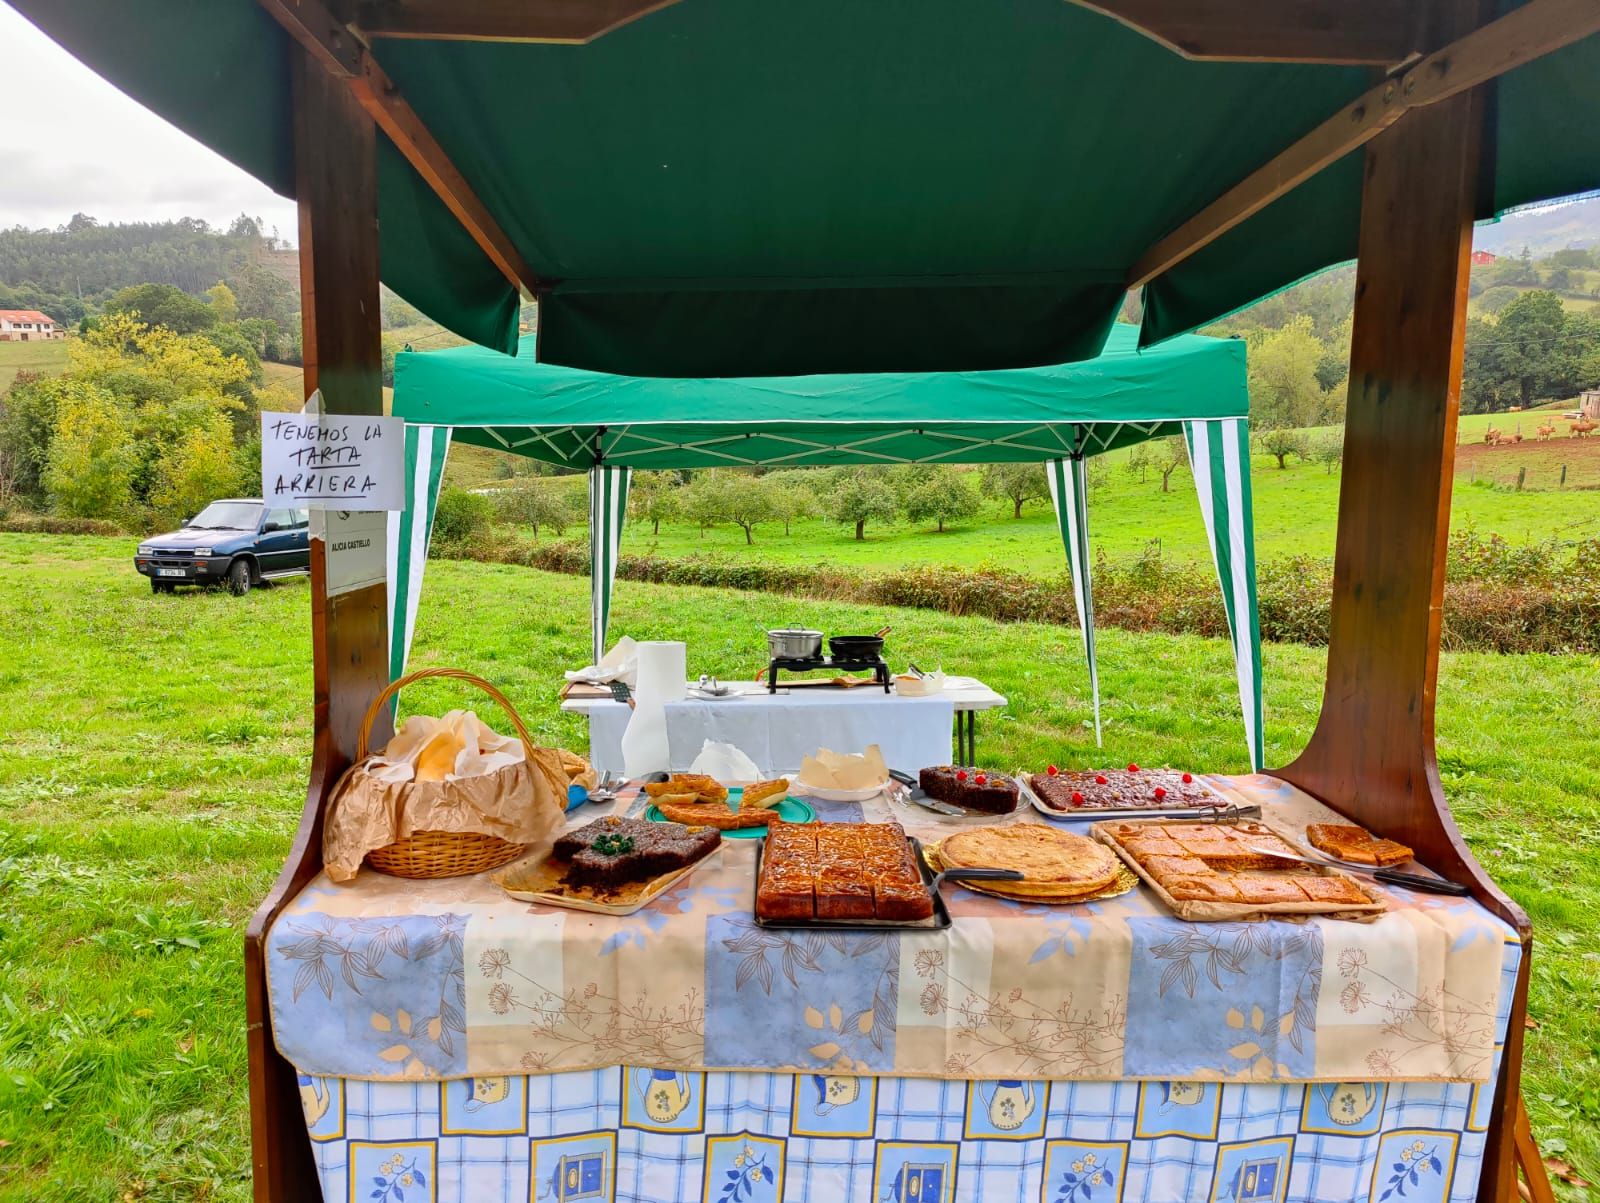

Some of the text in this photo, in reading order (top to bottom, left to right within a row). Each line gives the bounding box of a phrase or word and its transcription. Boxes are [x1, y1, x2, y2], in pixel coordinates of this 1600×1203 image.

[270, 420, 383, 442] TENEMOS LA
[289, 445, 362, 467] TARTA
[275, 473, 376, 495] ARRIERA
[332, 538, 371, 552] ALICIA CASTELLO
